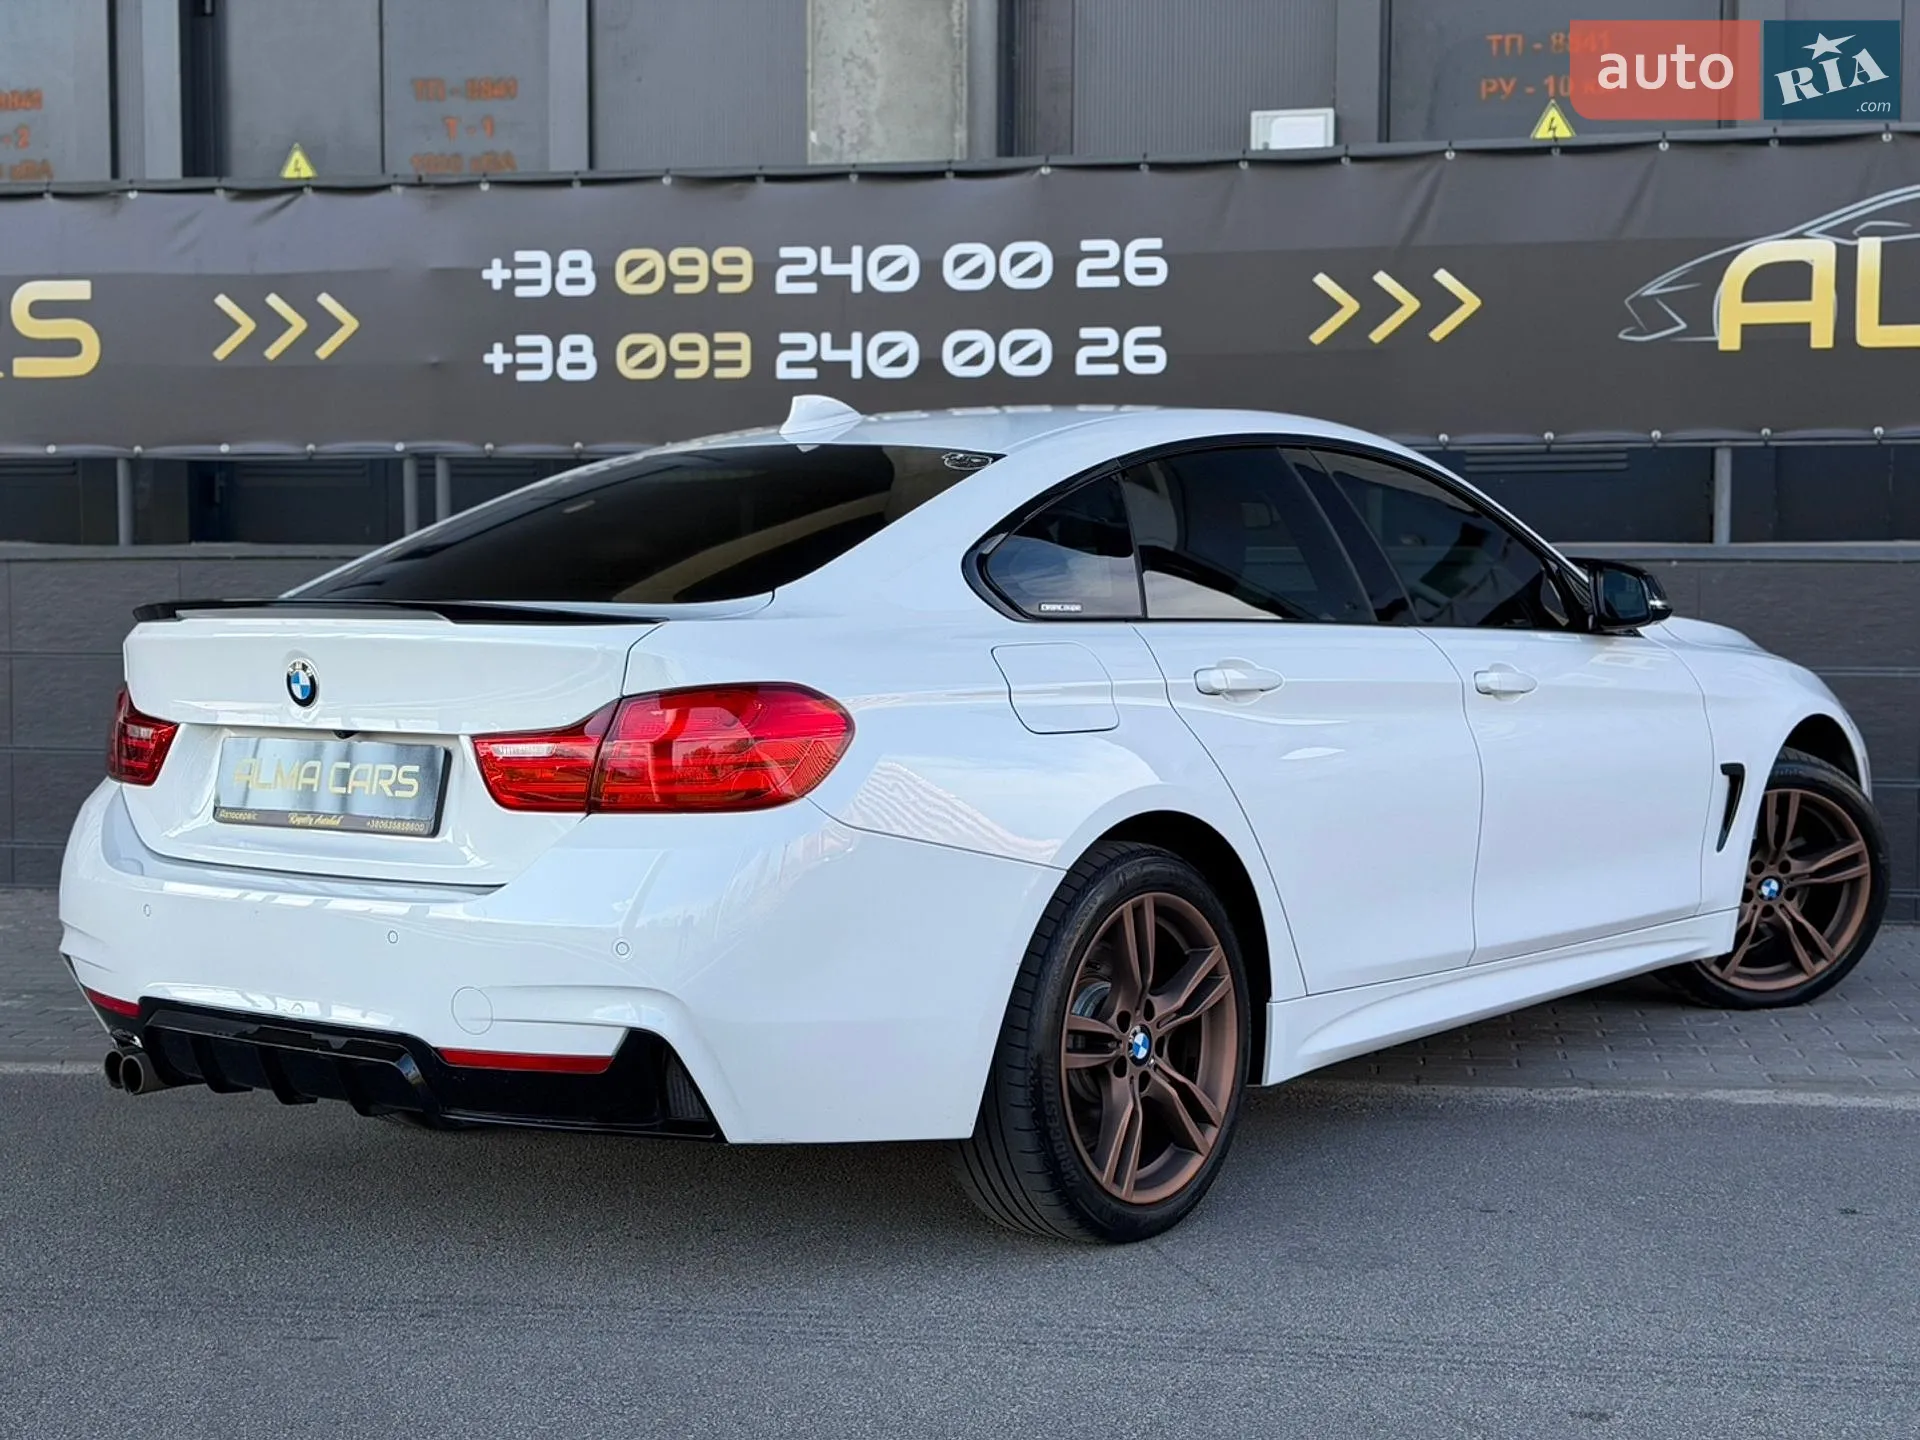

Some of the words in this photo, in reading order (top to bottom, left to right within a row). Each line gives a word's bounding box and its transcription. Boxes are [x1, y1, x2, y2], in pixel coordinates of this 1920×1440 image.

[15, 124, 31, 150] 2
[482, 249, 596, 297] +38
[615, 246, 753, 294] 099
[775, 244, 920, 294] 240
[943, 241, 1053, 291] 00
[1076, 238, 1168, 288] 26
[0, 279, 101, 378] S
[483, 334, 597, 381] +38
[616, 332, 751, 379] 093
[776, 331, 919, 379] 240
[942, 329, 1052, 377] 00
[1076, 326, 1167, 375] 26
[233, 758, 322, 793] ALMA
[328, 761, 420, 799] CARS
